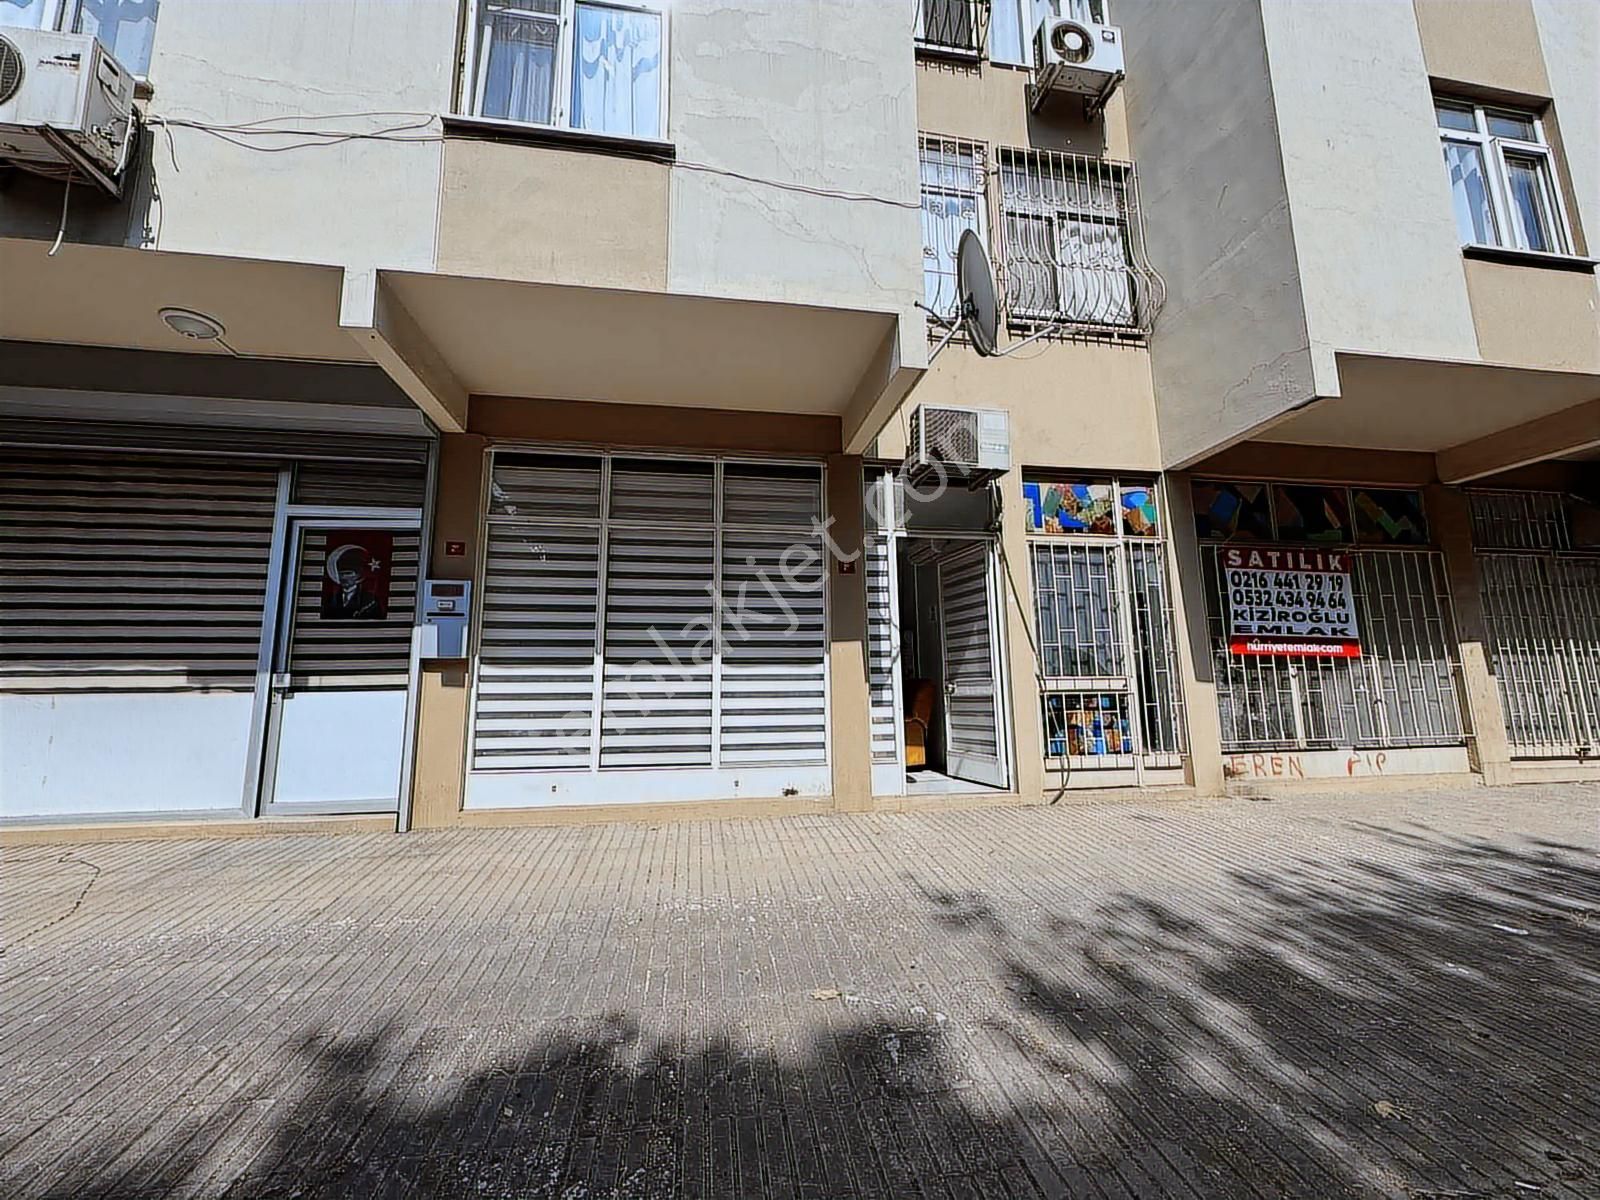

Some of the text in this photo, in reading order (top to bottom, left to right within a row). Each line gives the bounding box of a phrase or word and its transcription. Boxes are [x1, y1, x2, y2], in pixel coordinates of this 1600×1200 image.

[1228, 549, 1342, 570] SATILIK
[1230, 570, 1343, 591] 0216 441 29 19
[1232, 588, 1346, 609] 0532 434 94 64
[1233, 606, 1350, 623] KİZİROĞLU
[1234, 625, 1350, 636] EMLAK
[1231, 754, 1304, 778] EREN
